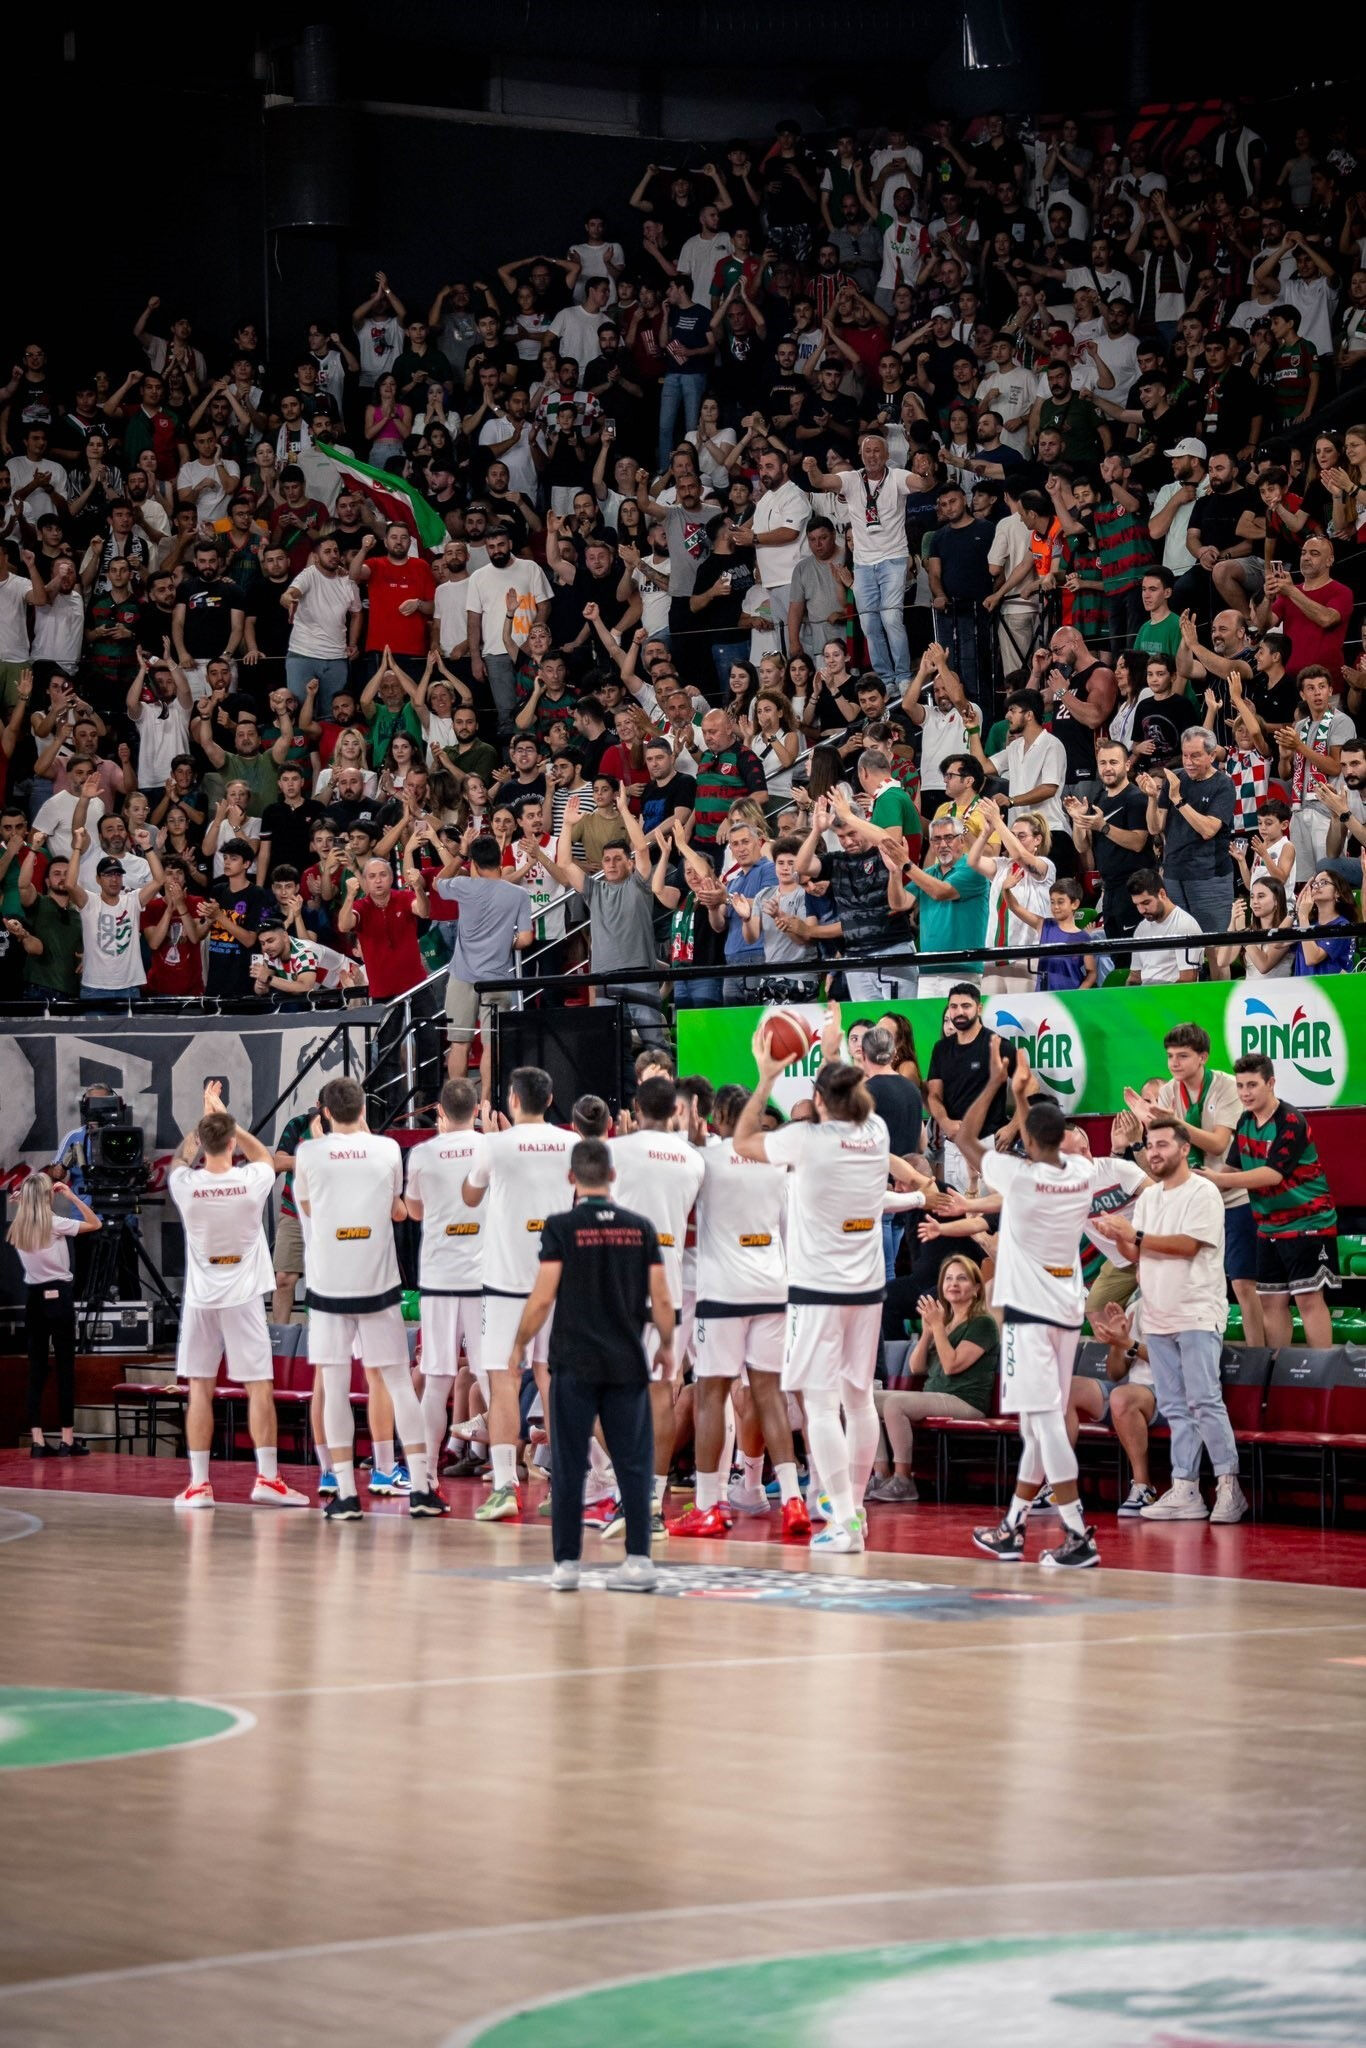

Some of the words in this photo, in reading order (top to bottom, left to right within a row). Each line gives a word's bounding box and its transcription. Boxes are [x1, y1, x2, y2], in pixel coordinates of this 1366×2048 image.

[1240, 1021, 1333, 1060] PINAR
[1010, 1033, 1073, 1068] NAR
[649, 1150, 687, 1164] BROWN
[192, 1185, 247, 1198] AKYAZILI
[336, 1226, 372, 1240] CMS
[446, 1223, 480, 1235] CMS
